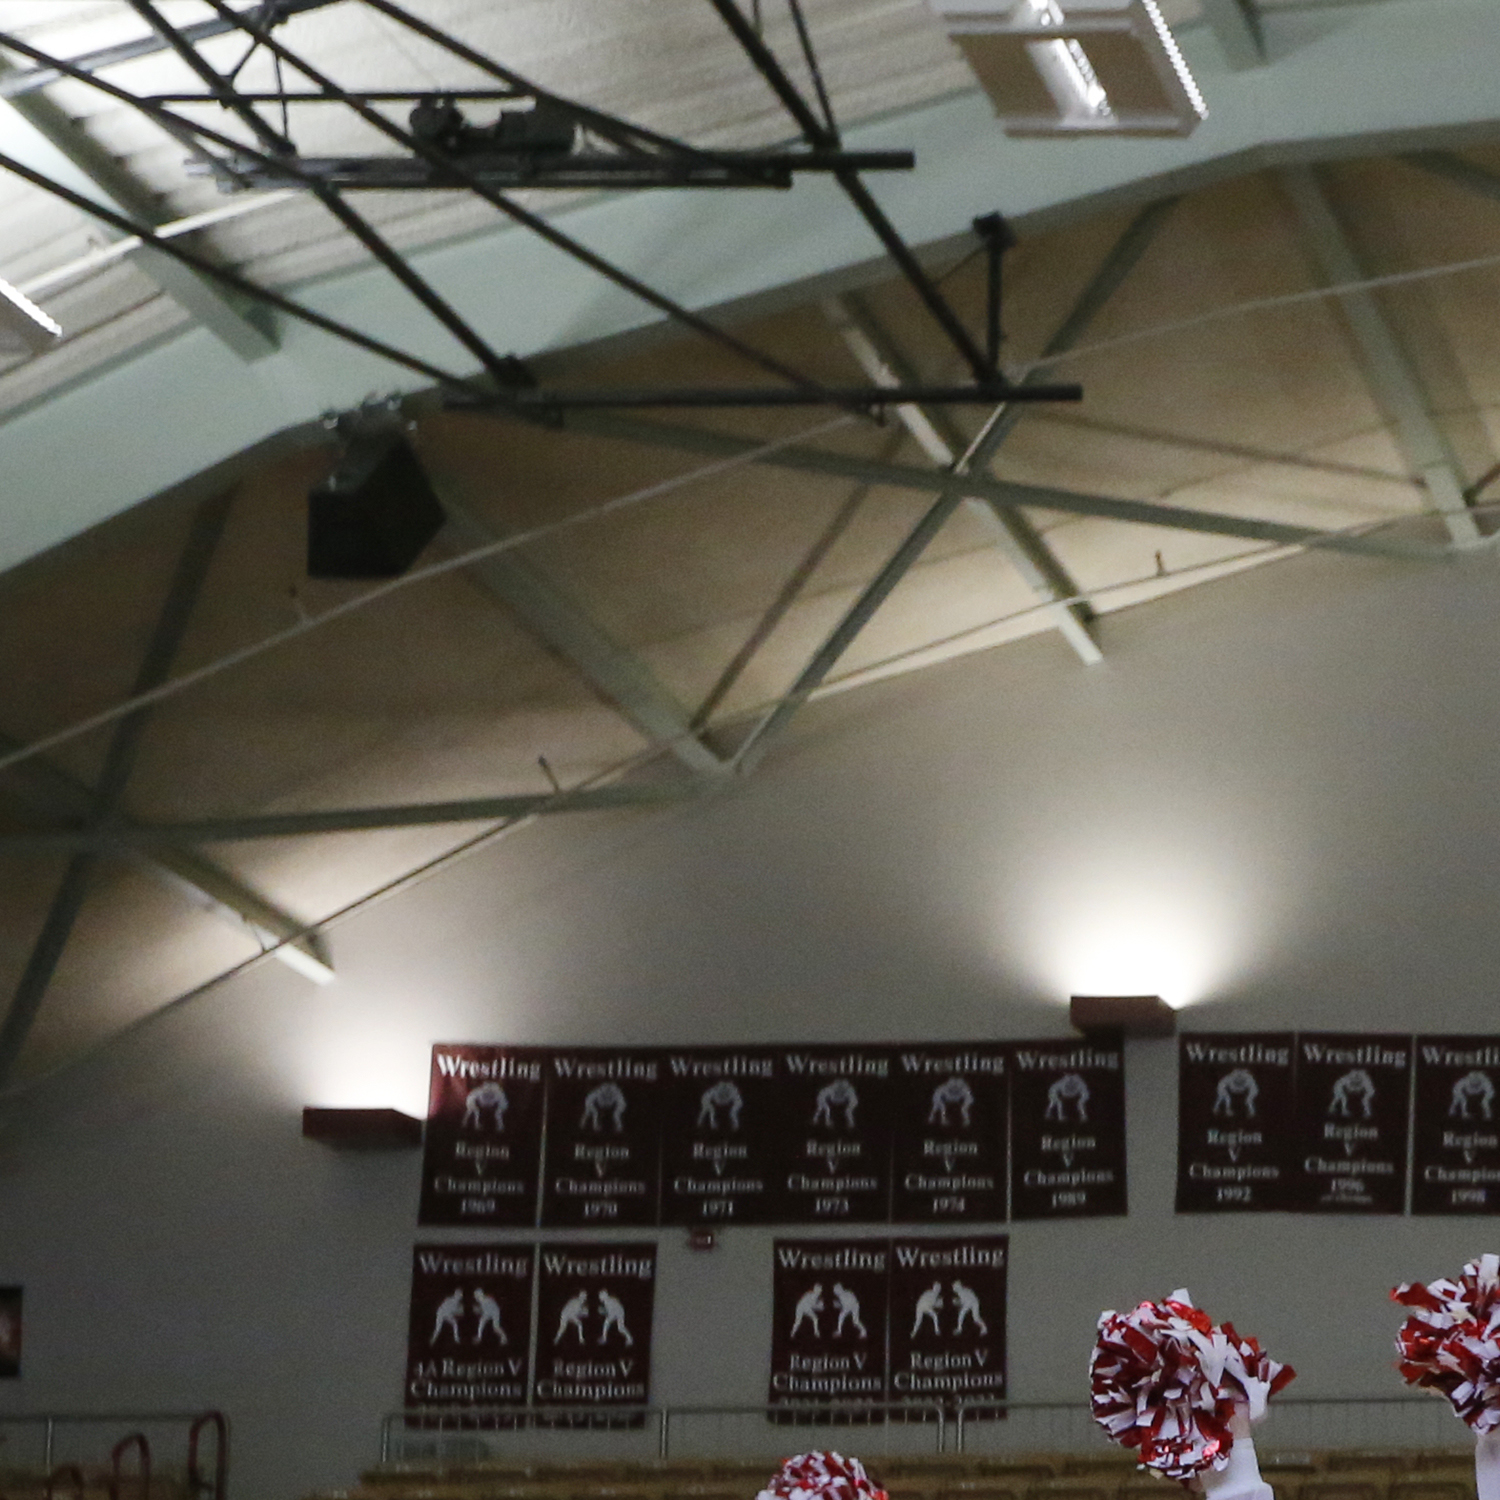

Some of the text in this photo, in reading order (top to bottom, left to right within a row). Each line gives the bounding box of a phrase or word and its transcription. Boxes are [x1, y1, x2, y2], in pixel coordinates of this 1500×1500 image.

[785, 1052, 889, 1078] Wrestling
[901, 1052, 1005, 1076] Wrestling
[1016, 1049, 1119, 1071] Wrestling
[1186, 1043, 1289, 1068] Wrestling
[1303, 1043, 1407, 1069] Wrestling
[437, 1054, 541, 1081] Wrestling
[554, 1056, 657, 1082] Wrestling
[669, 1055, 773, 1079] Wrestling
[1207, 1129, 1262, 1147] Region
[1324, 1123, 1379, 1142] Region
[1443, 1131, 1498, 1149] Region
[456, 1142, 510, 1160] Region
[574, 1143, 630, 1161] Region
[693, 1142, 748, 1161] Region
[806, 1139, 861, 1158] Region
[923, 1138, 978, 1157] Region
[1041, 1134, 1096, 1152] Region
[1189, 1164, 1280, 1183] Champions
[1304, 1157, 1394, 1176] Champions
[434, 1178, 524, 1195] Champions
[555, 1178, 645, 1195] Champions
[674, 1178, 763, 1195] Champions
[786, 1173, 878, 1192] Champions
[904, 1173, 994, 1191] Champions
[1023, 1169, 1114, 1187] Champions
[419, 1252, 529, 1278] Wrestling
[543, 1253, 652, 1279] Wrestling
[779, 1248, 886, 1273] Wrestling
[896, 1246, 1004, 1270] Wrestling
[442, 1359, 523, 1381] Region V
[553, 1360, 634, 1381] Region V
[789, 1352, 867, 1373] Region V
[910, 1349, 989, 1373] Region V
[410, 1381, 522, 1400] Champions
[536, 1381, 645, 1400] Champions
[773, 1372, 882, 1394] Champions
[894, 1371, 1003, 1392] Champions
